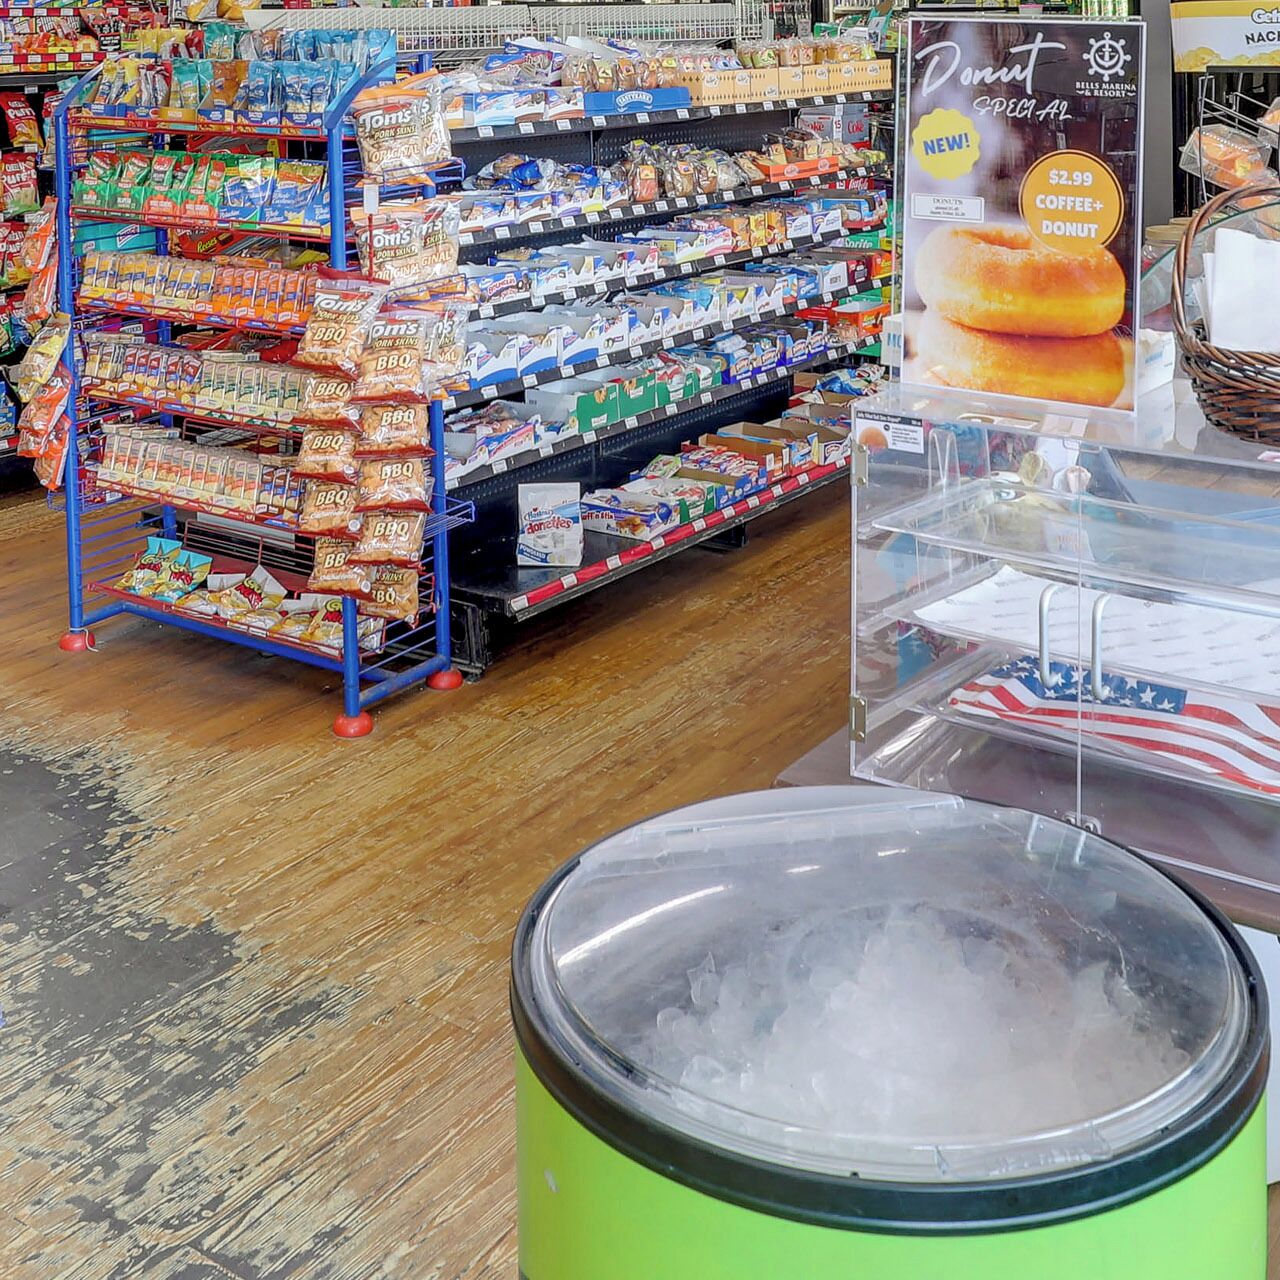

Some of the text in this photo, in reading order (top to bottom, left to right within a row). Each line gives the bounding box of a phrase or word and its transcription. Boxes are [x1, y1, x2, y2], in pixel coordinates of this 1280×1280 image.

[915, 32, 1066, 97] Donut
[1102, 82, 1136, 91] MARINA
[359, 108, 413, 129] Tom's
[374, 126, 416, 141] PORK SKINS
[923, 132, 970, 155] NEW!
[372, 143, 420, 163] ORIGINAL
[1049, 171, 1093, 186] $2.99
[932, 198, 963, 206] DONUTS
[1036, 195, 1104, 211] COFFEE+
[1042, 221, 1098, 238] DONUT
[422, 252, 452, 266] GINAL
[313, 327, 346, 343] BBQ
[376, 353, 412, 371] BBQ
[315, 382, 348, 397] BBQ
[381, 409, 415, 426] BBQ
[311, 434, 344, 450] BBQ
